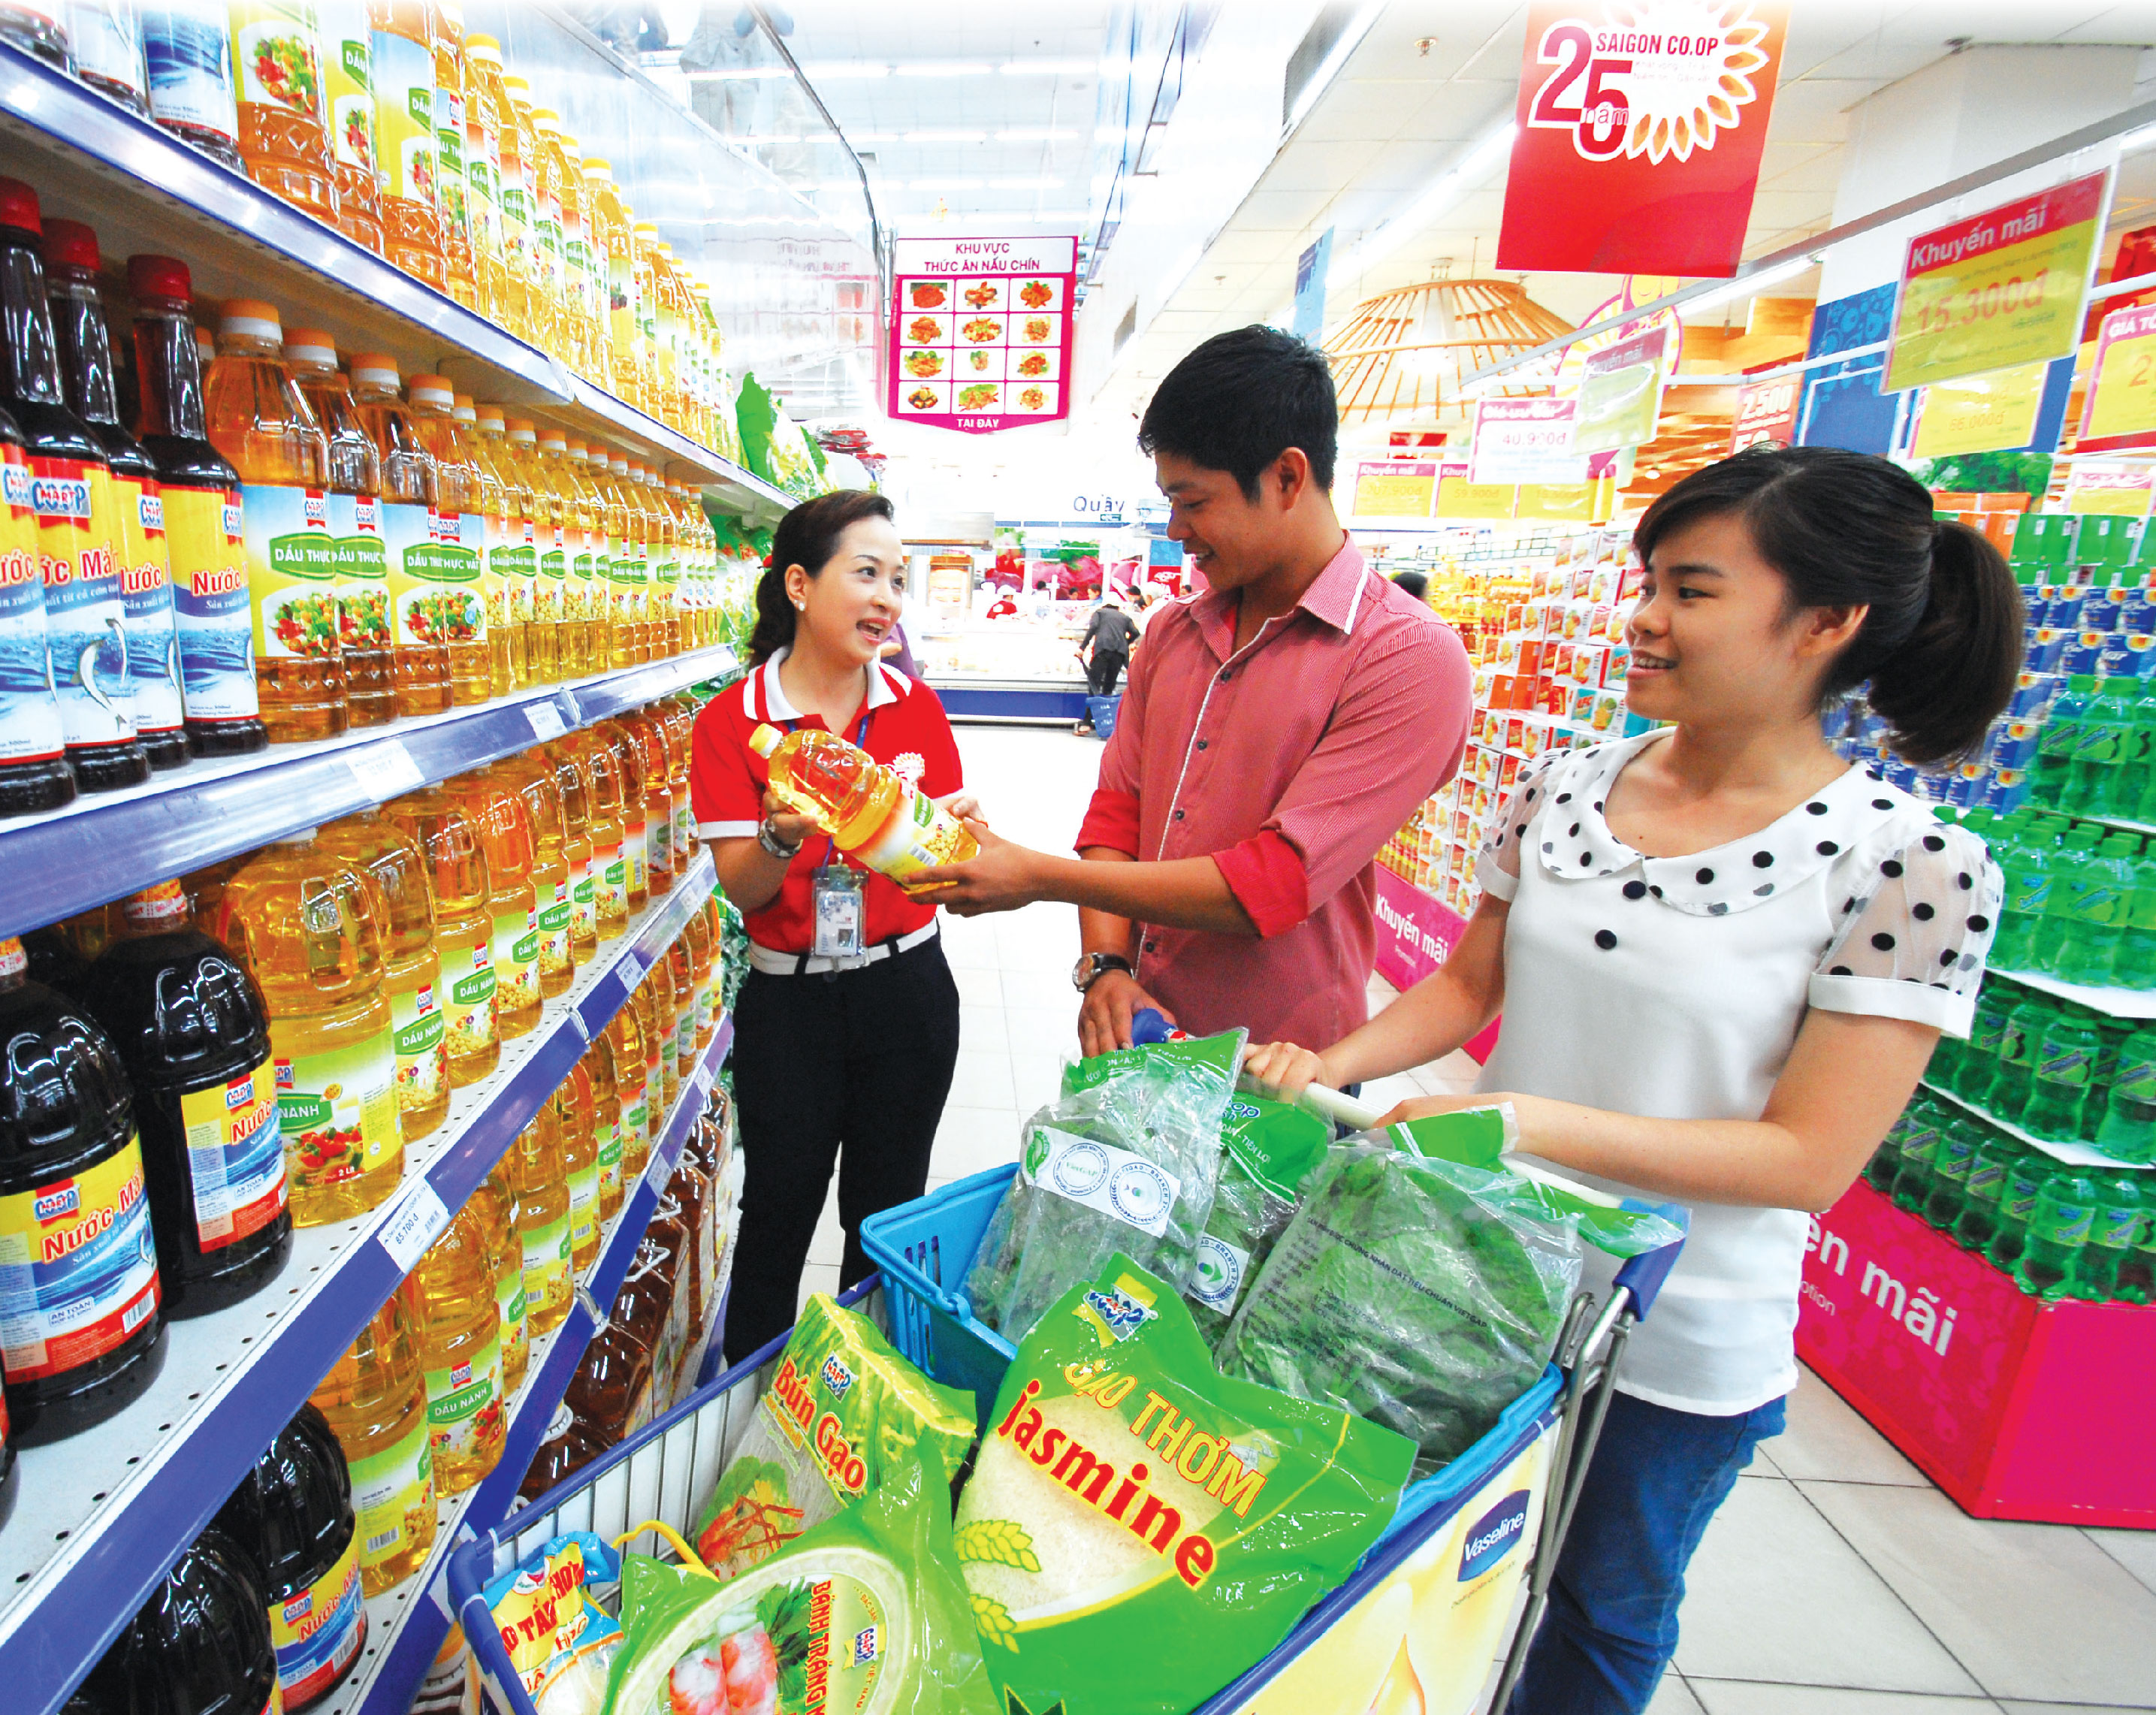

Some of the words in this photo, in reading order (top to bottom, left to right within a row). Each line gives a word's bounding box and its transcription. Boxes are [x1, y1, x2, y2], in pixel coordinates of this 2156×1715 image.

[1596, 32, 1661, 55] SAIGON
[1666, 35, 1718, 56] CO.OP
[1534, 26, 1632, 155] 25
[1583, 101, 1629, 126] năm
[956, 243, 981, 254] KHU
[985, 242, 1010, 255] VỰC
[1911, 226, 1994, 270] Khuyến
[2000, 204, 2048, 241] mãi
[925, 258, 959, 272] THỨC
[962, 259, 978, 271] ĂN
[982, 256, 1007, 271] NẤU
[1011, 257, 1040, 270] CHÍN
[1918, 267, 2049, 336] 15.300đ
[957, 418, 974, 430] TẠI
[977, 417, 999, 428] ĐÂY
[1442, 467, 1467, 478] Khuy
[192, 566, 242, 597] Nước
[443, 558, 464, 572] HỰC
[1375, 894, 1420, 947] Khuyến
[1422, 932, 1449, 965] mãi
[1230, 1102, 1261, 1119] op
[42, 1208, 113, 1264] Nước
[1451, 1301, 1490, 1330] VIETGAP
[1860, 1261, 1958, 1357] mãi
[774, 1357, 816, 1435] Bún
[816, 1412, 867, 1492] Gạo
[1128, 1390, 1268, 1518] THƠM
[996, 1379, 1215, 1588] jasmine
[1465, 1511, 1525, 1561] Vaseline
[808, 1580, 836, 1637] BÁNH
